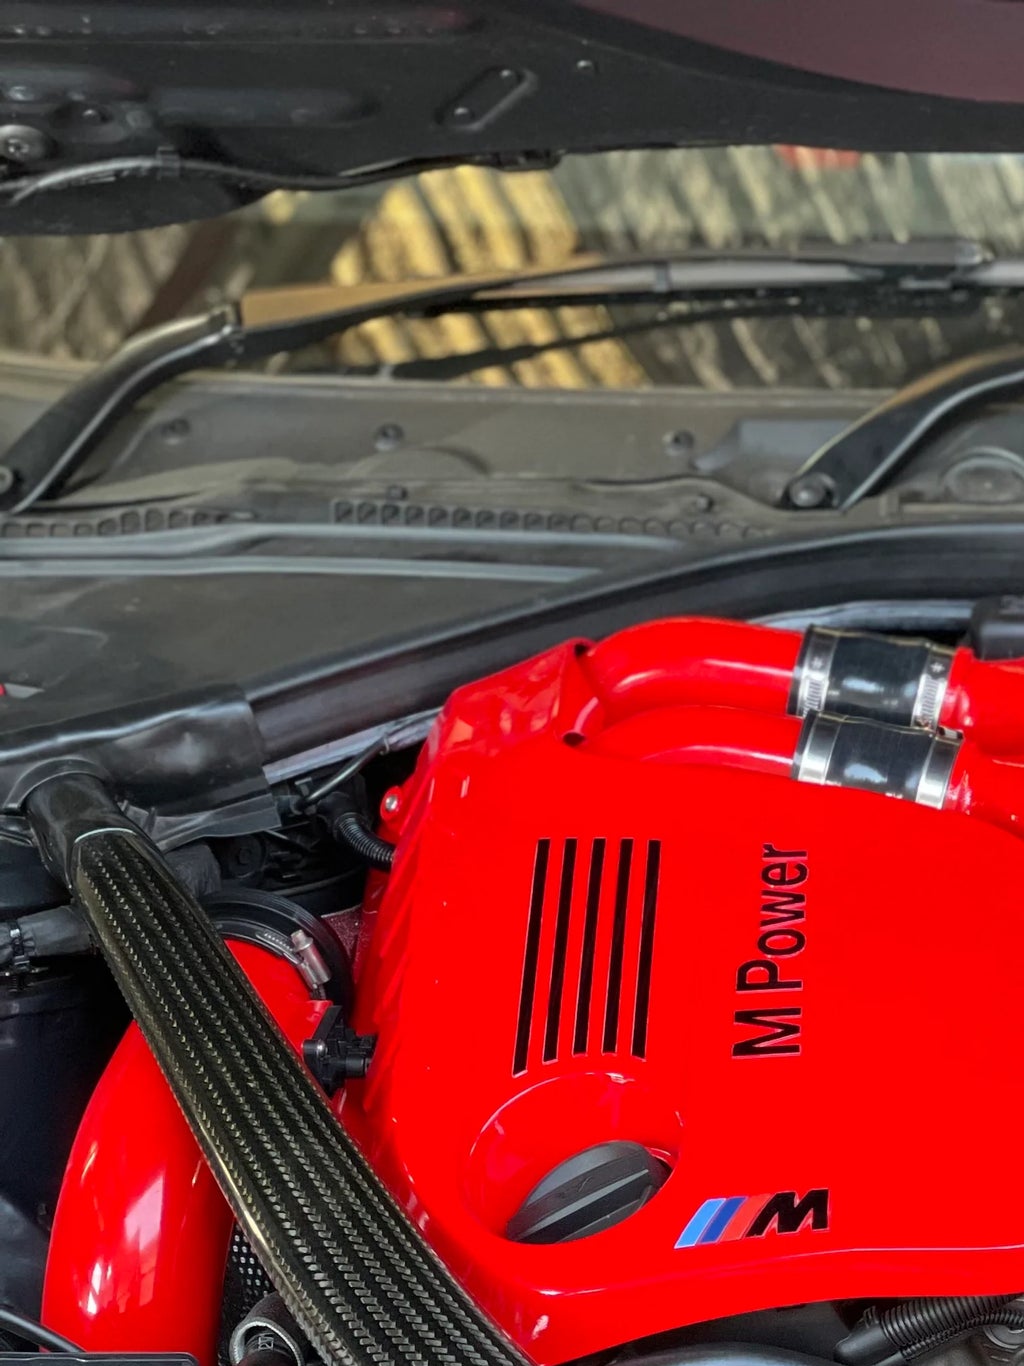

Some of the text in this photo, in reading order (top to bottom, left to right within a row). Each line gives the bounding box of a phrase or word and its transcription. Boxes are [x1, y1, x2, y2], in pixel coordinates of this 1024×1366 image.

[731, 842, 809, 1059] M Power
[745, 1188, 831, 1239] M
